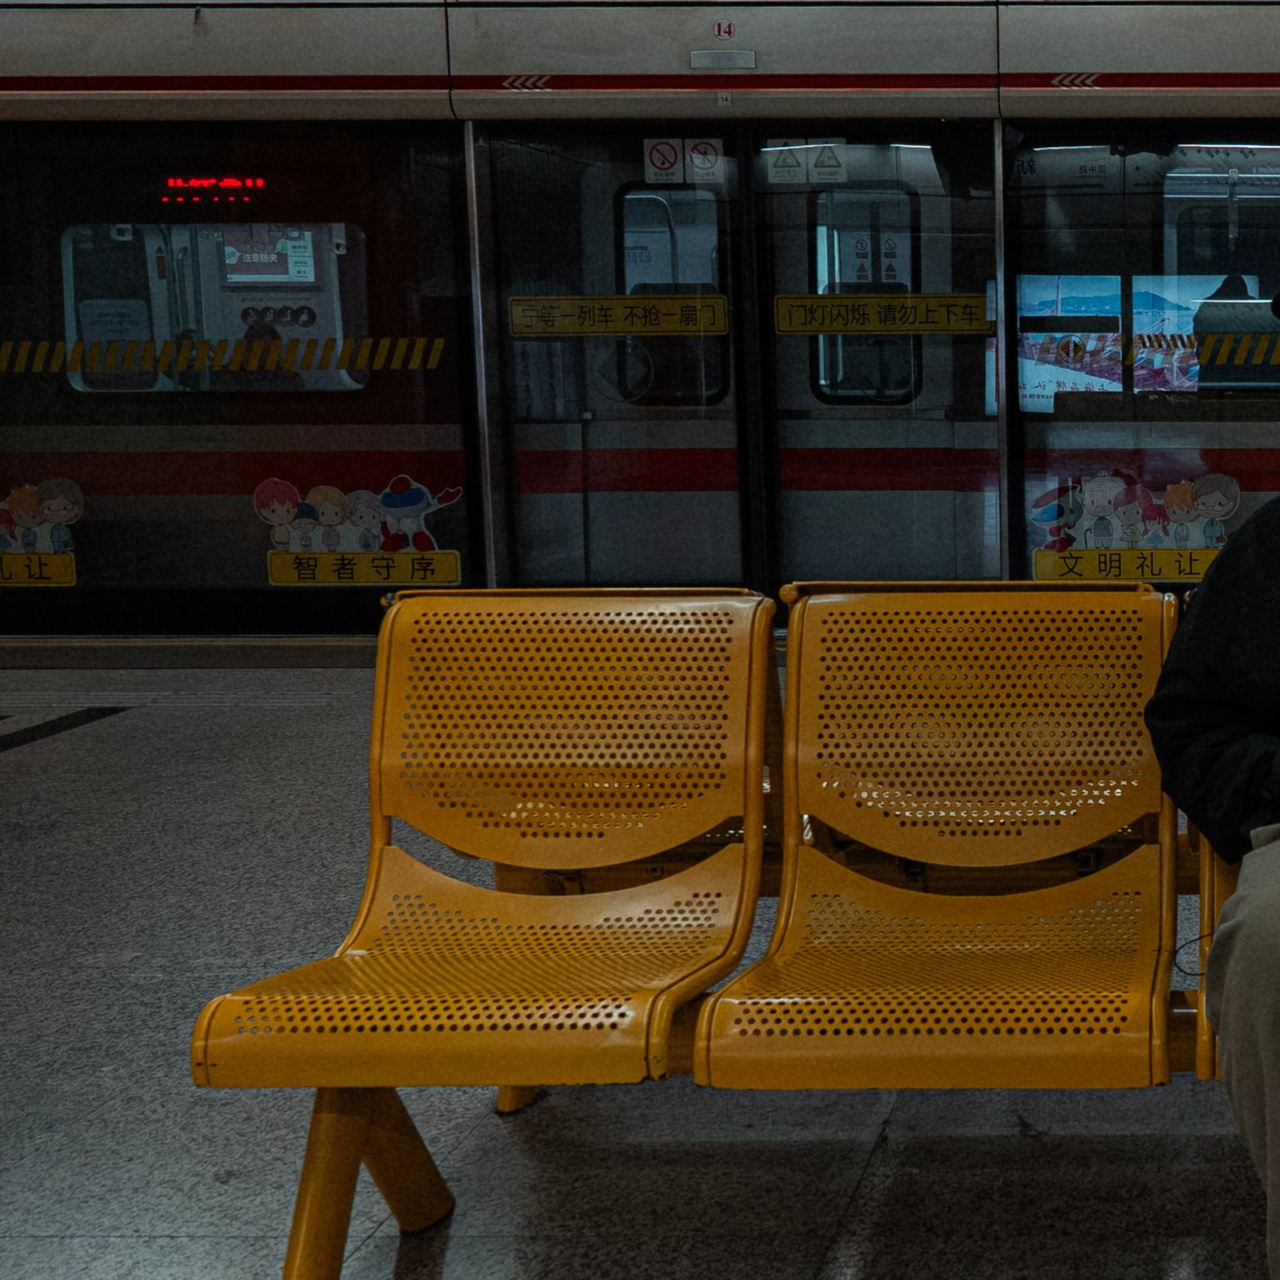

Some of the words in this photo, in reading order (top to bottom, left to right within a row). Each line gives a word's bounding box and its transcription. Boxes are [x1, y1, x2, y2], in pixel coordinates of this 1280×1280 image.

[716, 22, 733, 37] 14
[521, 304, 615, 328] 宁等一列车
[623, 304, 717, 328] 不抢一扇门
[788, 303, 871, 326] 门灯闪烁
[876, 303, 981, 326] 请勿上下车
[292, 555, 437, 581] 智者守序
[1058, 551, 1200, 578] 文明礼让
